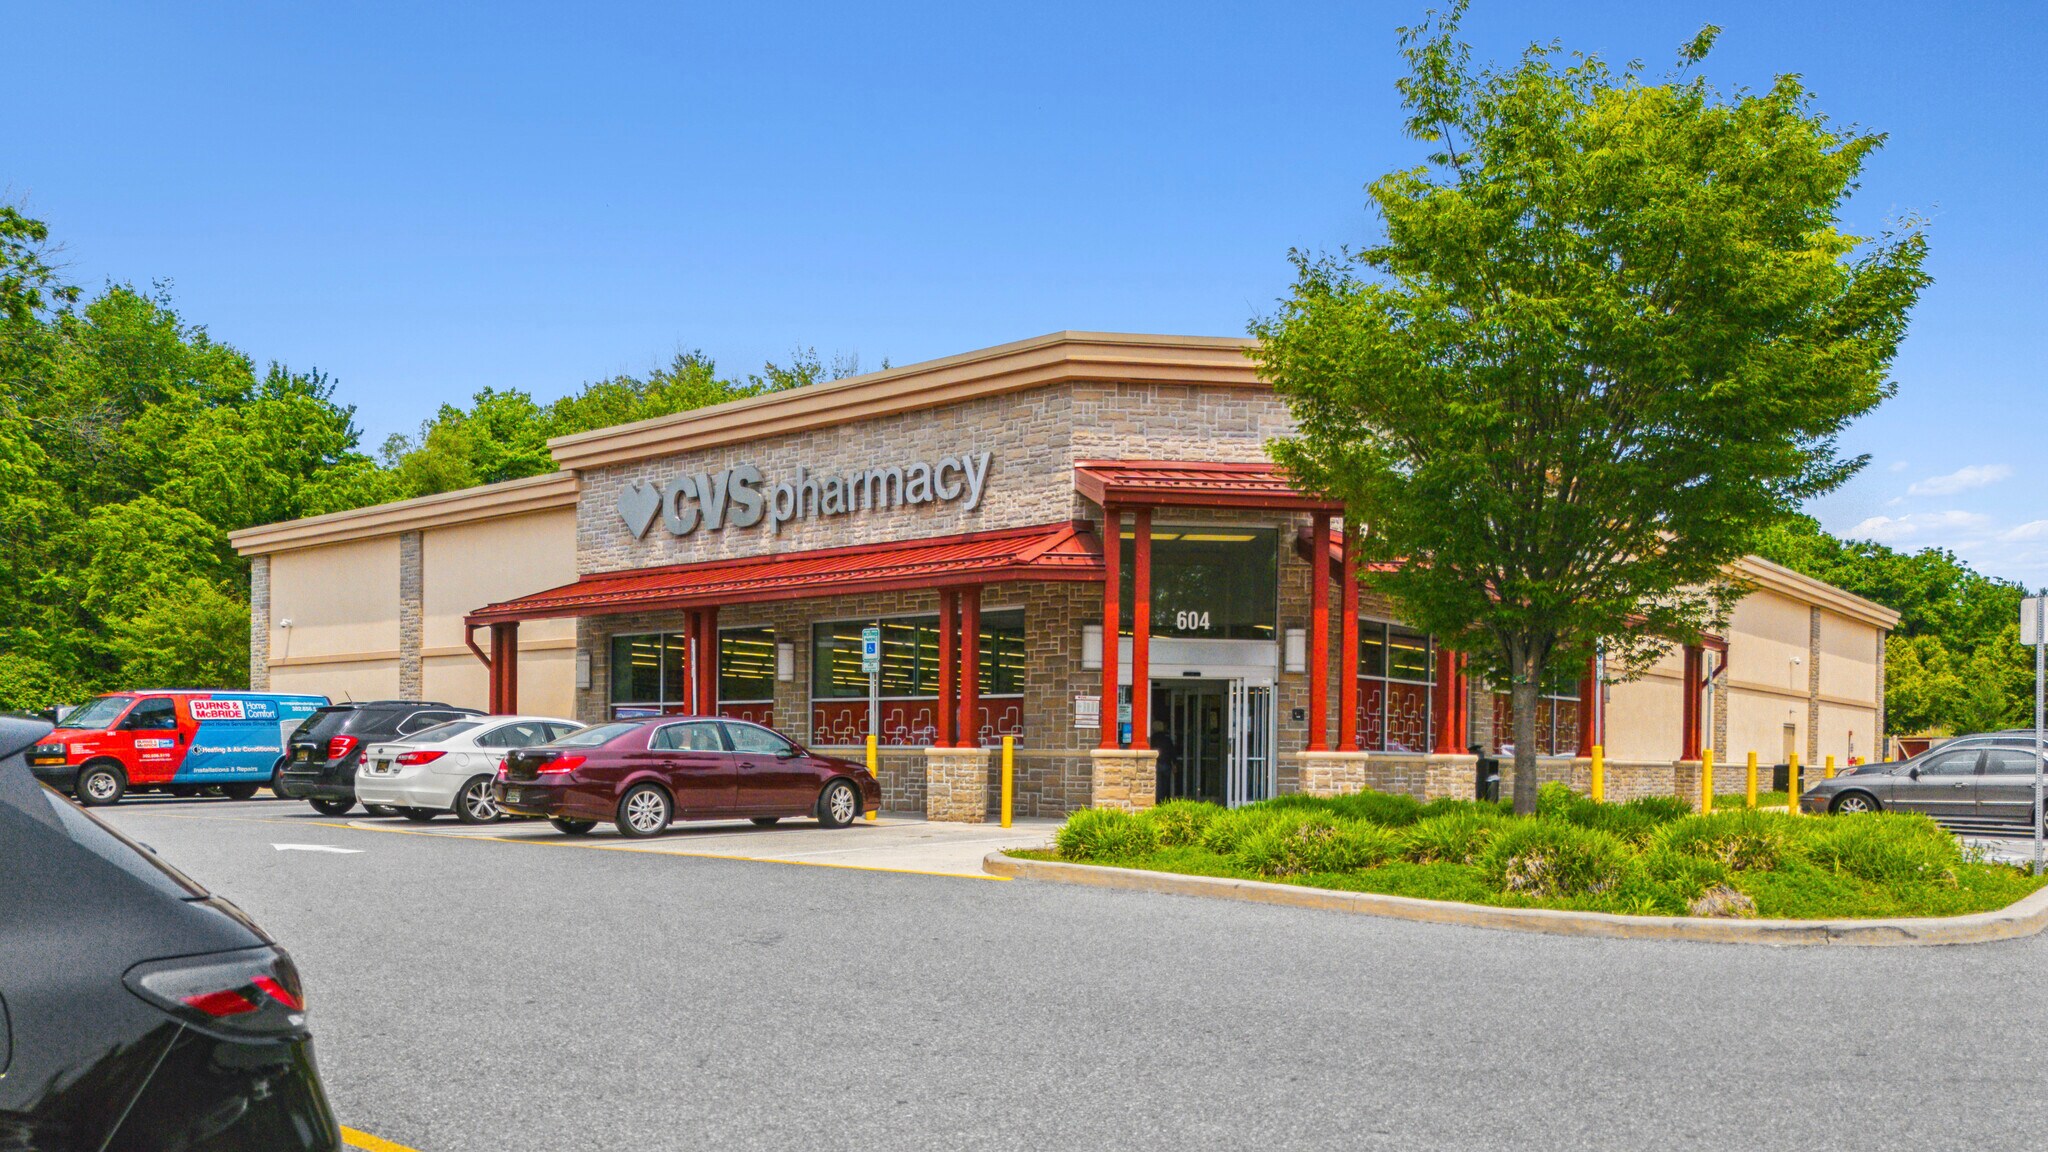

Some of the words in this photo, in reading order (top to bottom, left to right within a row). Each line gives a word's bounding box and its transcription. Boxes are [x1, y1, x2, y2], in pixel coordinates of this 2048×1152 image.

[662, 464, 766, 537] CVS
[770, 451, 993, 535] pharmacy
[1176, 611, 1210, 630] 604
[196, 710, 242, 718] McBRIDE
[247, 709, 275, 719] Comfort
[202, 747, 226, 755] Heating
[243, 746, 280, 754] Conditioning
